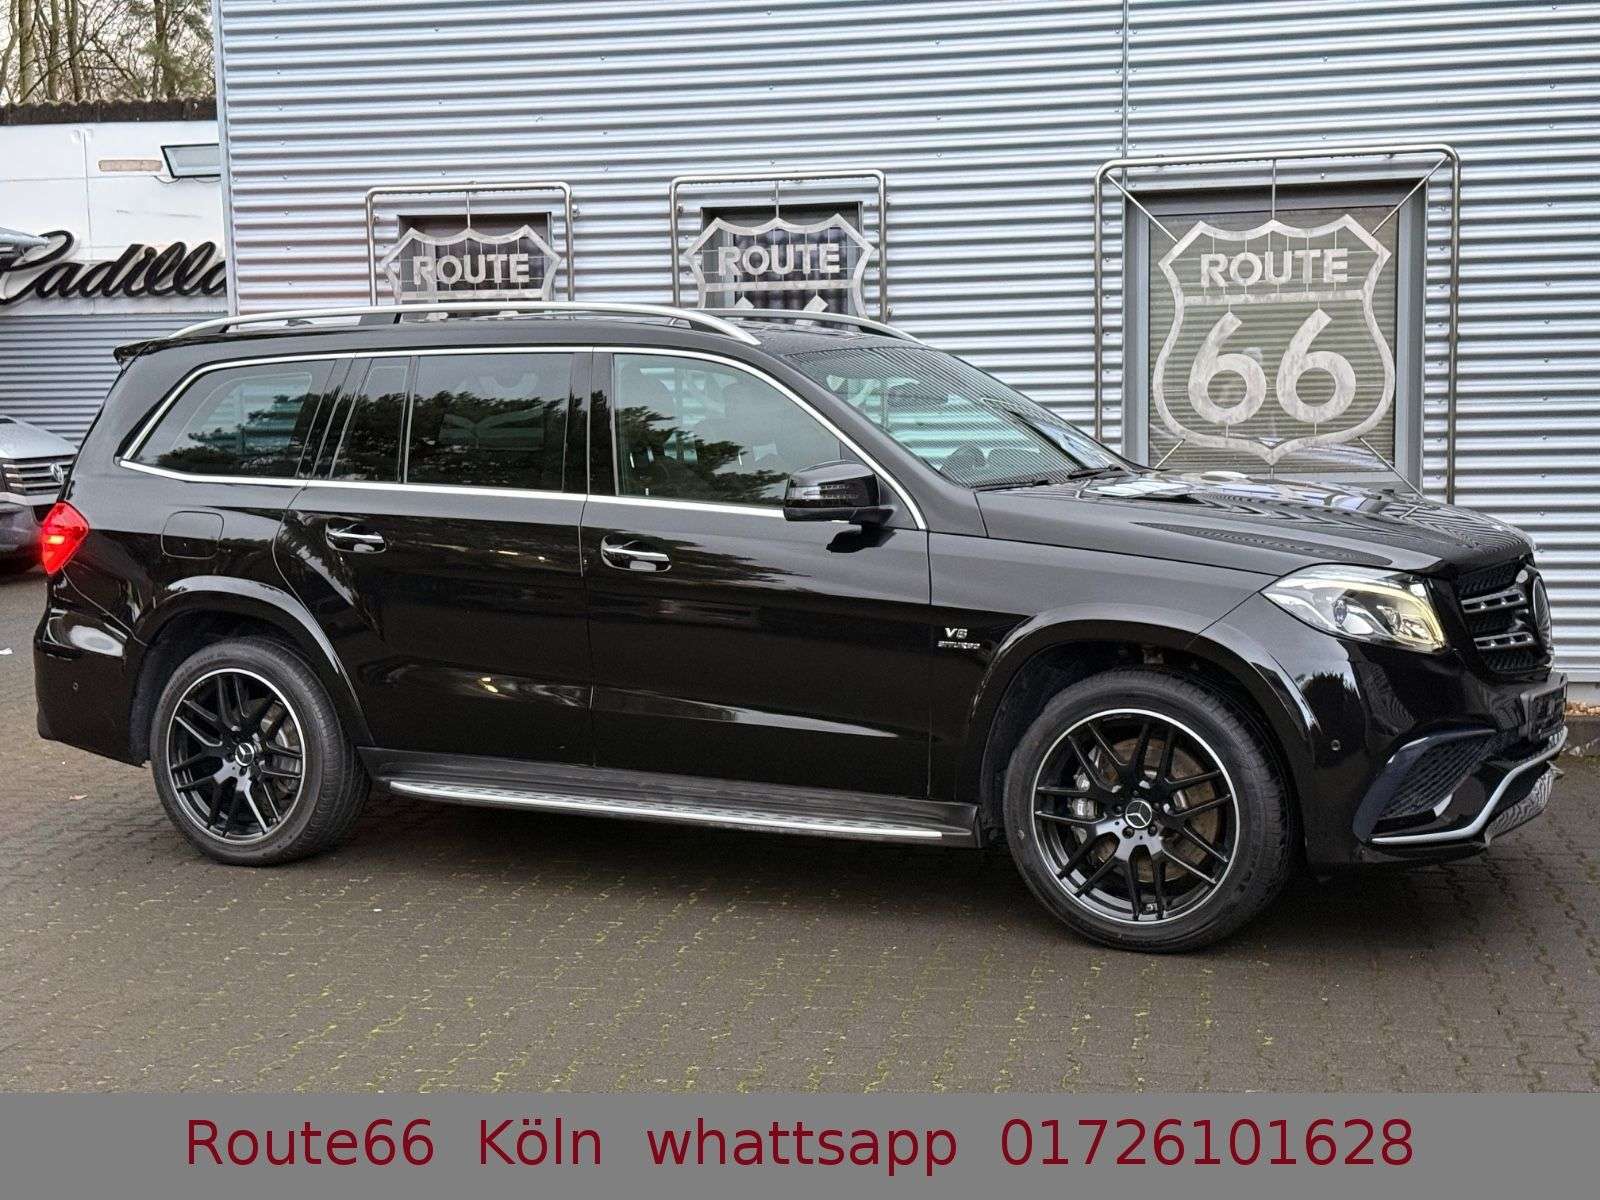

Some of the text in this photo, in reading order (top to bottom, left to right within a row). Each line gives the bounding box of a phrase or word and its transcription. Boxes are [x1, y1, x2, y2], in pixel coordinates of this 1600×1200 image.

[413, 252, 530, 285] ROUTE
[717, 242, 841, 275] ROUTE
[1200, 247, 1349, 288] ROUTE
[1188, 308, 1357, 426] 66
